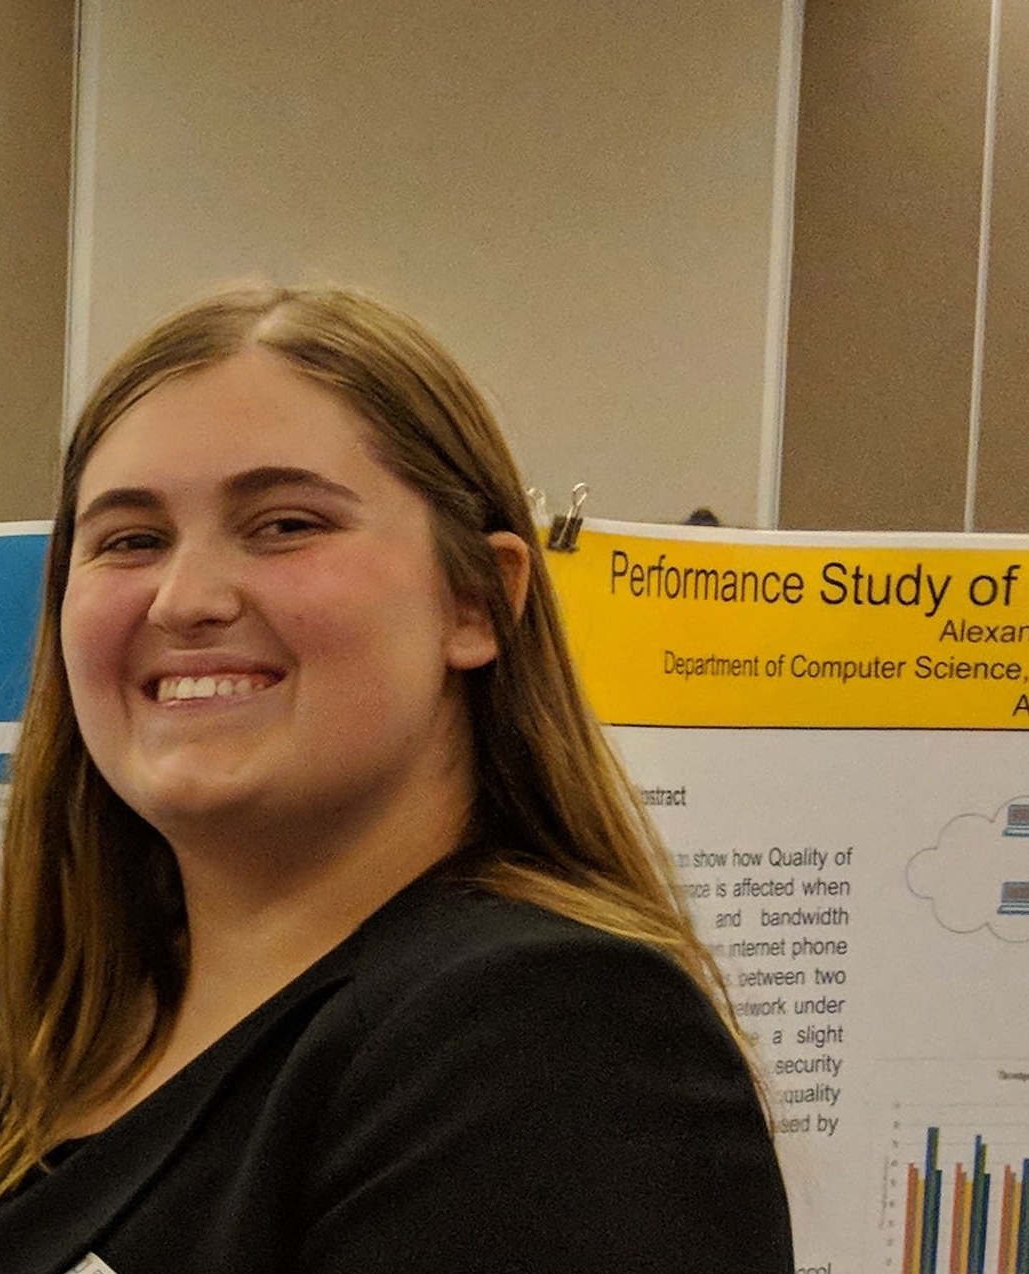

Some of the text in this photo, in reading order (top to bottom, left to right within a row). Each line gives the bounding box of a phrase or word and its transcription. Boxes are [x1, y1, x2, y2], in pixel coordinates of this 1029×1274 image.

[611, 549, 1020, 617] Performance Study of
[664, 650, 1029, 684] Department of Computer Science,
[693, 851, 727, 868] show
[732, 849, 762, 867] how
[769, 847, 828, 870] Quality
[834, 847, 853, 865] of
[716, 880, 727, 897] is
[733, 878, 795, 897] affected
[803, 878, 850, 895] when
[716, 907, 849, 928] and bandwidth
[791, 937, 848, 960] phone
[815, 969, 846, 984] two
[794, 997, 845, 1014] under
[773, 1025, 844, 1047] a slight
[775, 1054, 842, 1077] security
[817, 1113, 839, 1136] by
